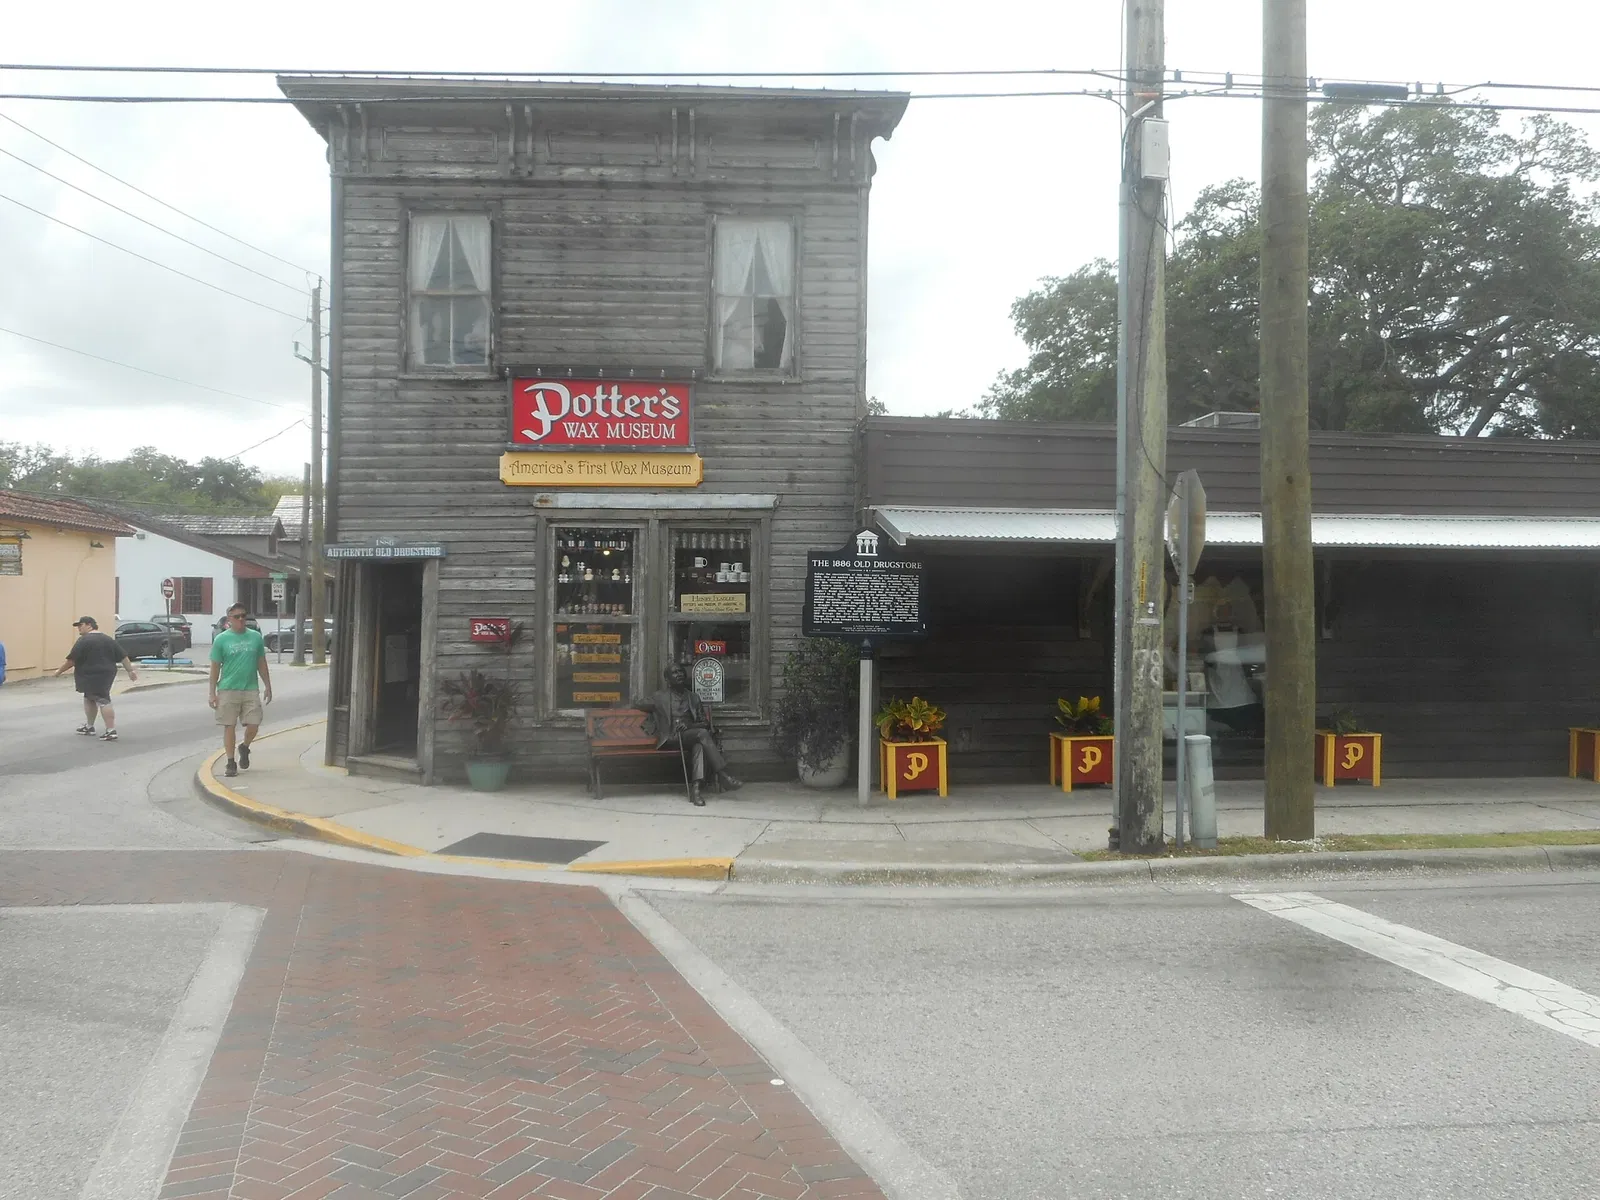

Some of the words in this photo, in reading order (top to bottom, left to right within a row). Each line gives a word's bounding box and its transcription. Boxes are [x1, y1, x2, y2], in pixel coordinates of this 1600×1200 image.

[521, 382, 681, 441] Potter's
[562, 422, 599, 439] WAX
[607, 423, 676, 440] MUSEUM
[509, 460, 574, 476] America's
[578, 460, 607, 475] First
[610, 460, 637, 475] Wax
[641, 461, 692, 476] Museum
[327, 547, 374, 557] AUTHENTIC
[375, 547, 391, 557] OLD
[394, 546, 441, 556] DRUGSTORE
[812, 559, 830, 567] THE
[832, 560, 851, 568] 1886
[853, 560, 871, 568] OLD
[873, 561, 923, 570] DRUGSTORE
[699, 642, 721, 652] Open
